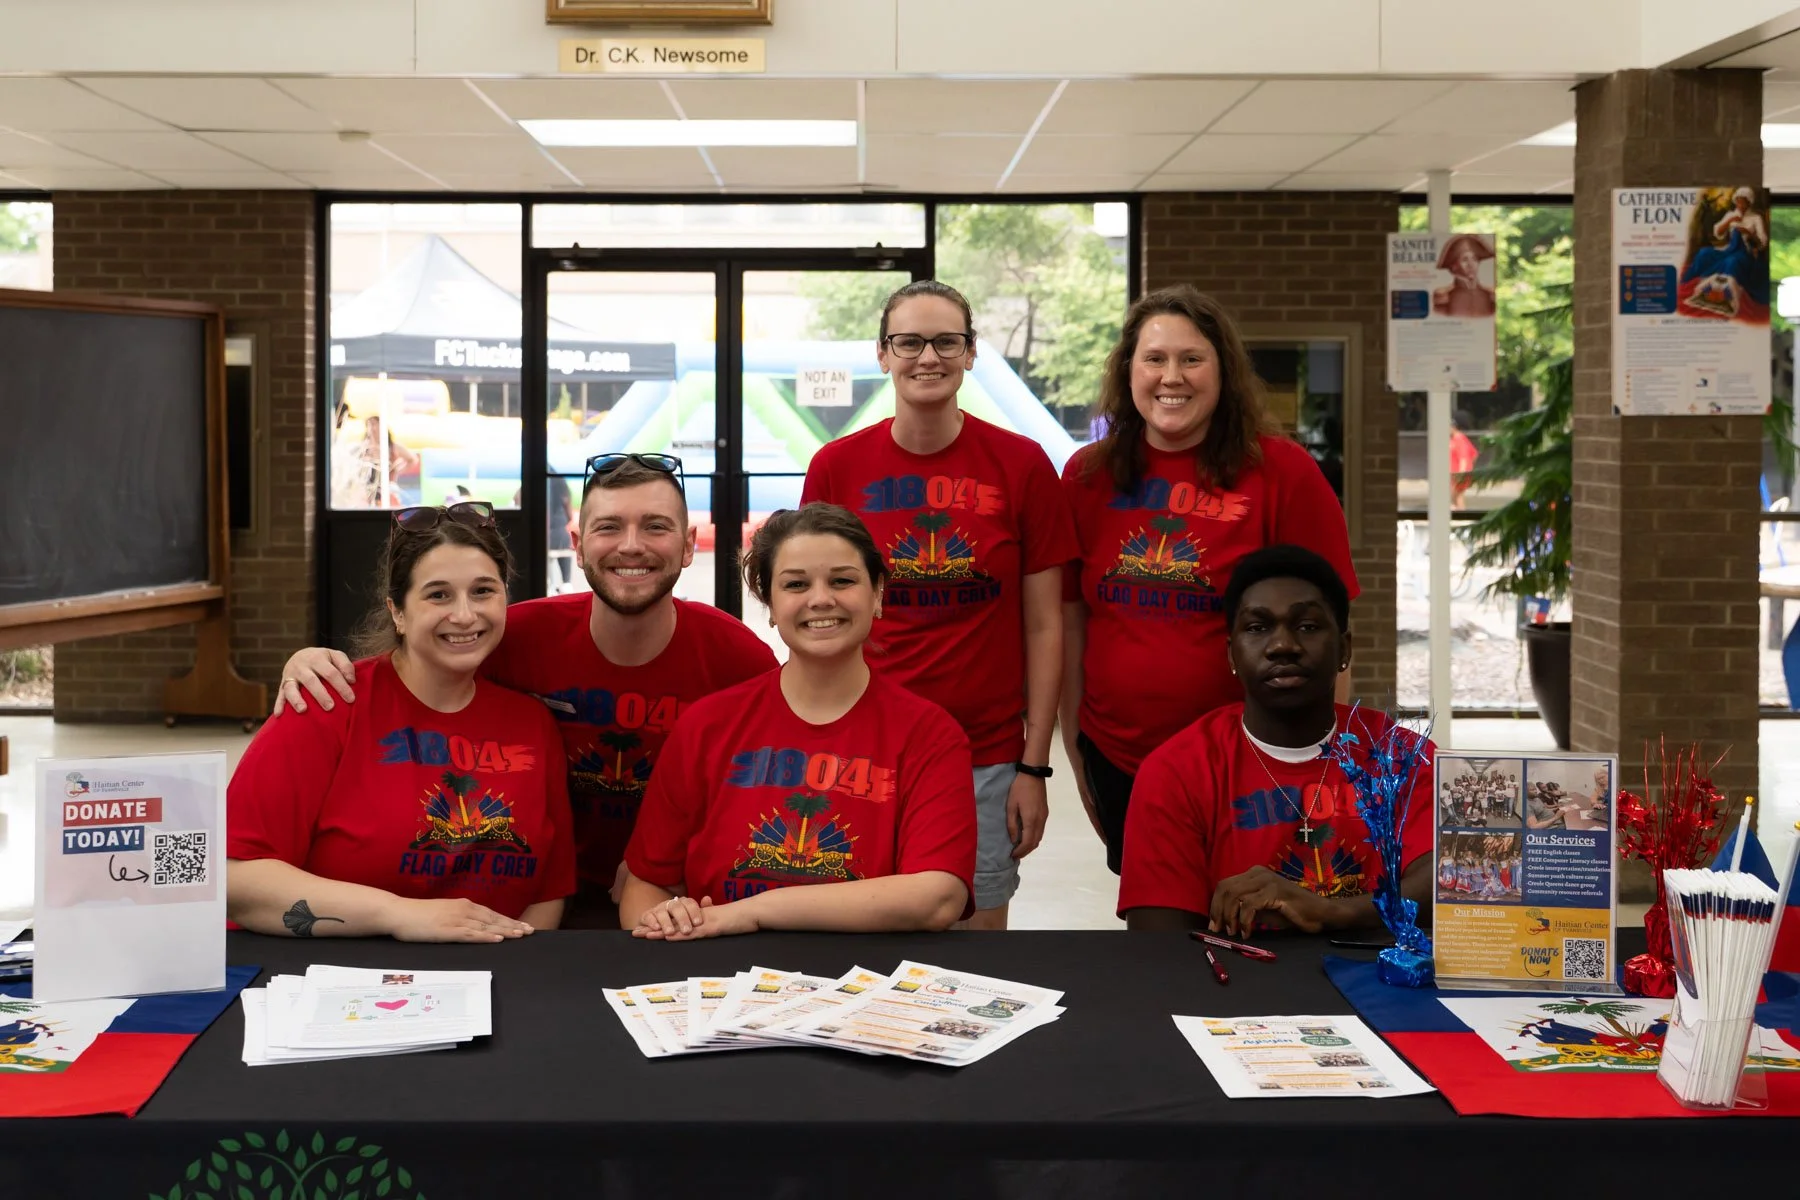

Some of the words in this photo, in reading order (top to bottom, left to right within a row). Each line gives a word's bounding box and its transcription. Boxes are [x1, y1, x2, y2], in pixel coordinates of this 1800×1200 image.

[575, 47, 599, 64] Dr.
[608, 47, 645, 64] C.K.
[654, 47, 749, 64] Newsome
[1618, 192, 1697, 206] CATHERINE
[1632, 208, 1682, 224] FLON
[804, 371, 827, 383] NOT
[830, 371, 846, 383] AN
[813, 387, 837, 400] EXIT
[881, 475, 979, 510] 1804
[889, 590, 911, 607] AG
[918, 590, 951, 607] DAY
[958, 580, 1001, 605] CREW
[1098, 584, 1131, 605] FLAG
[1138, 589, 1171, 608] DAY
[1177, 593, 1224, 613] CREW
[403, 726, 508, 773] 1804
[752, 746, 873, 799] 1804
[94, 781, 120, 789] Haitian
[122, 780, 144, 788] Center
[65, 801, 147, 821] DONATE
[64, 829, 140, 849] TODAY!
[1526, 834, 1548, 845] Our
[1550, 834, 1596, 846] Services
[399, 852, 447, 877] FLAG
[452, 852, 485, 876] DAY
[492, 855, 537, 879] CREW
[1454, 908, 1471, 917] Our
[1472, 908, 1506, 918] Mission
[1555, 920, 1582, 929] Haitian
[1584, 921, 1609, 930] Center
[1521, 947, 1559, 957] DONATE
[1529, 956, 1551, 965] NOW
